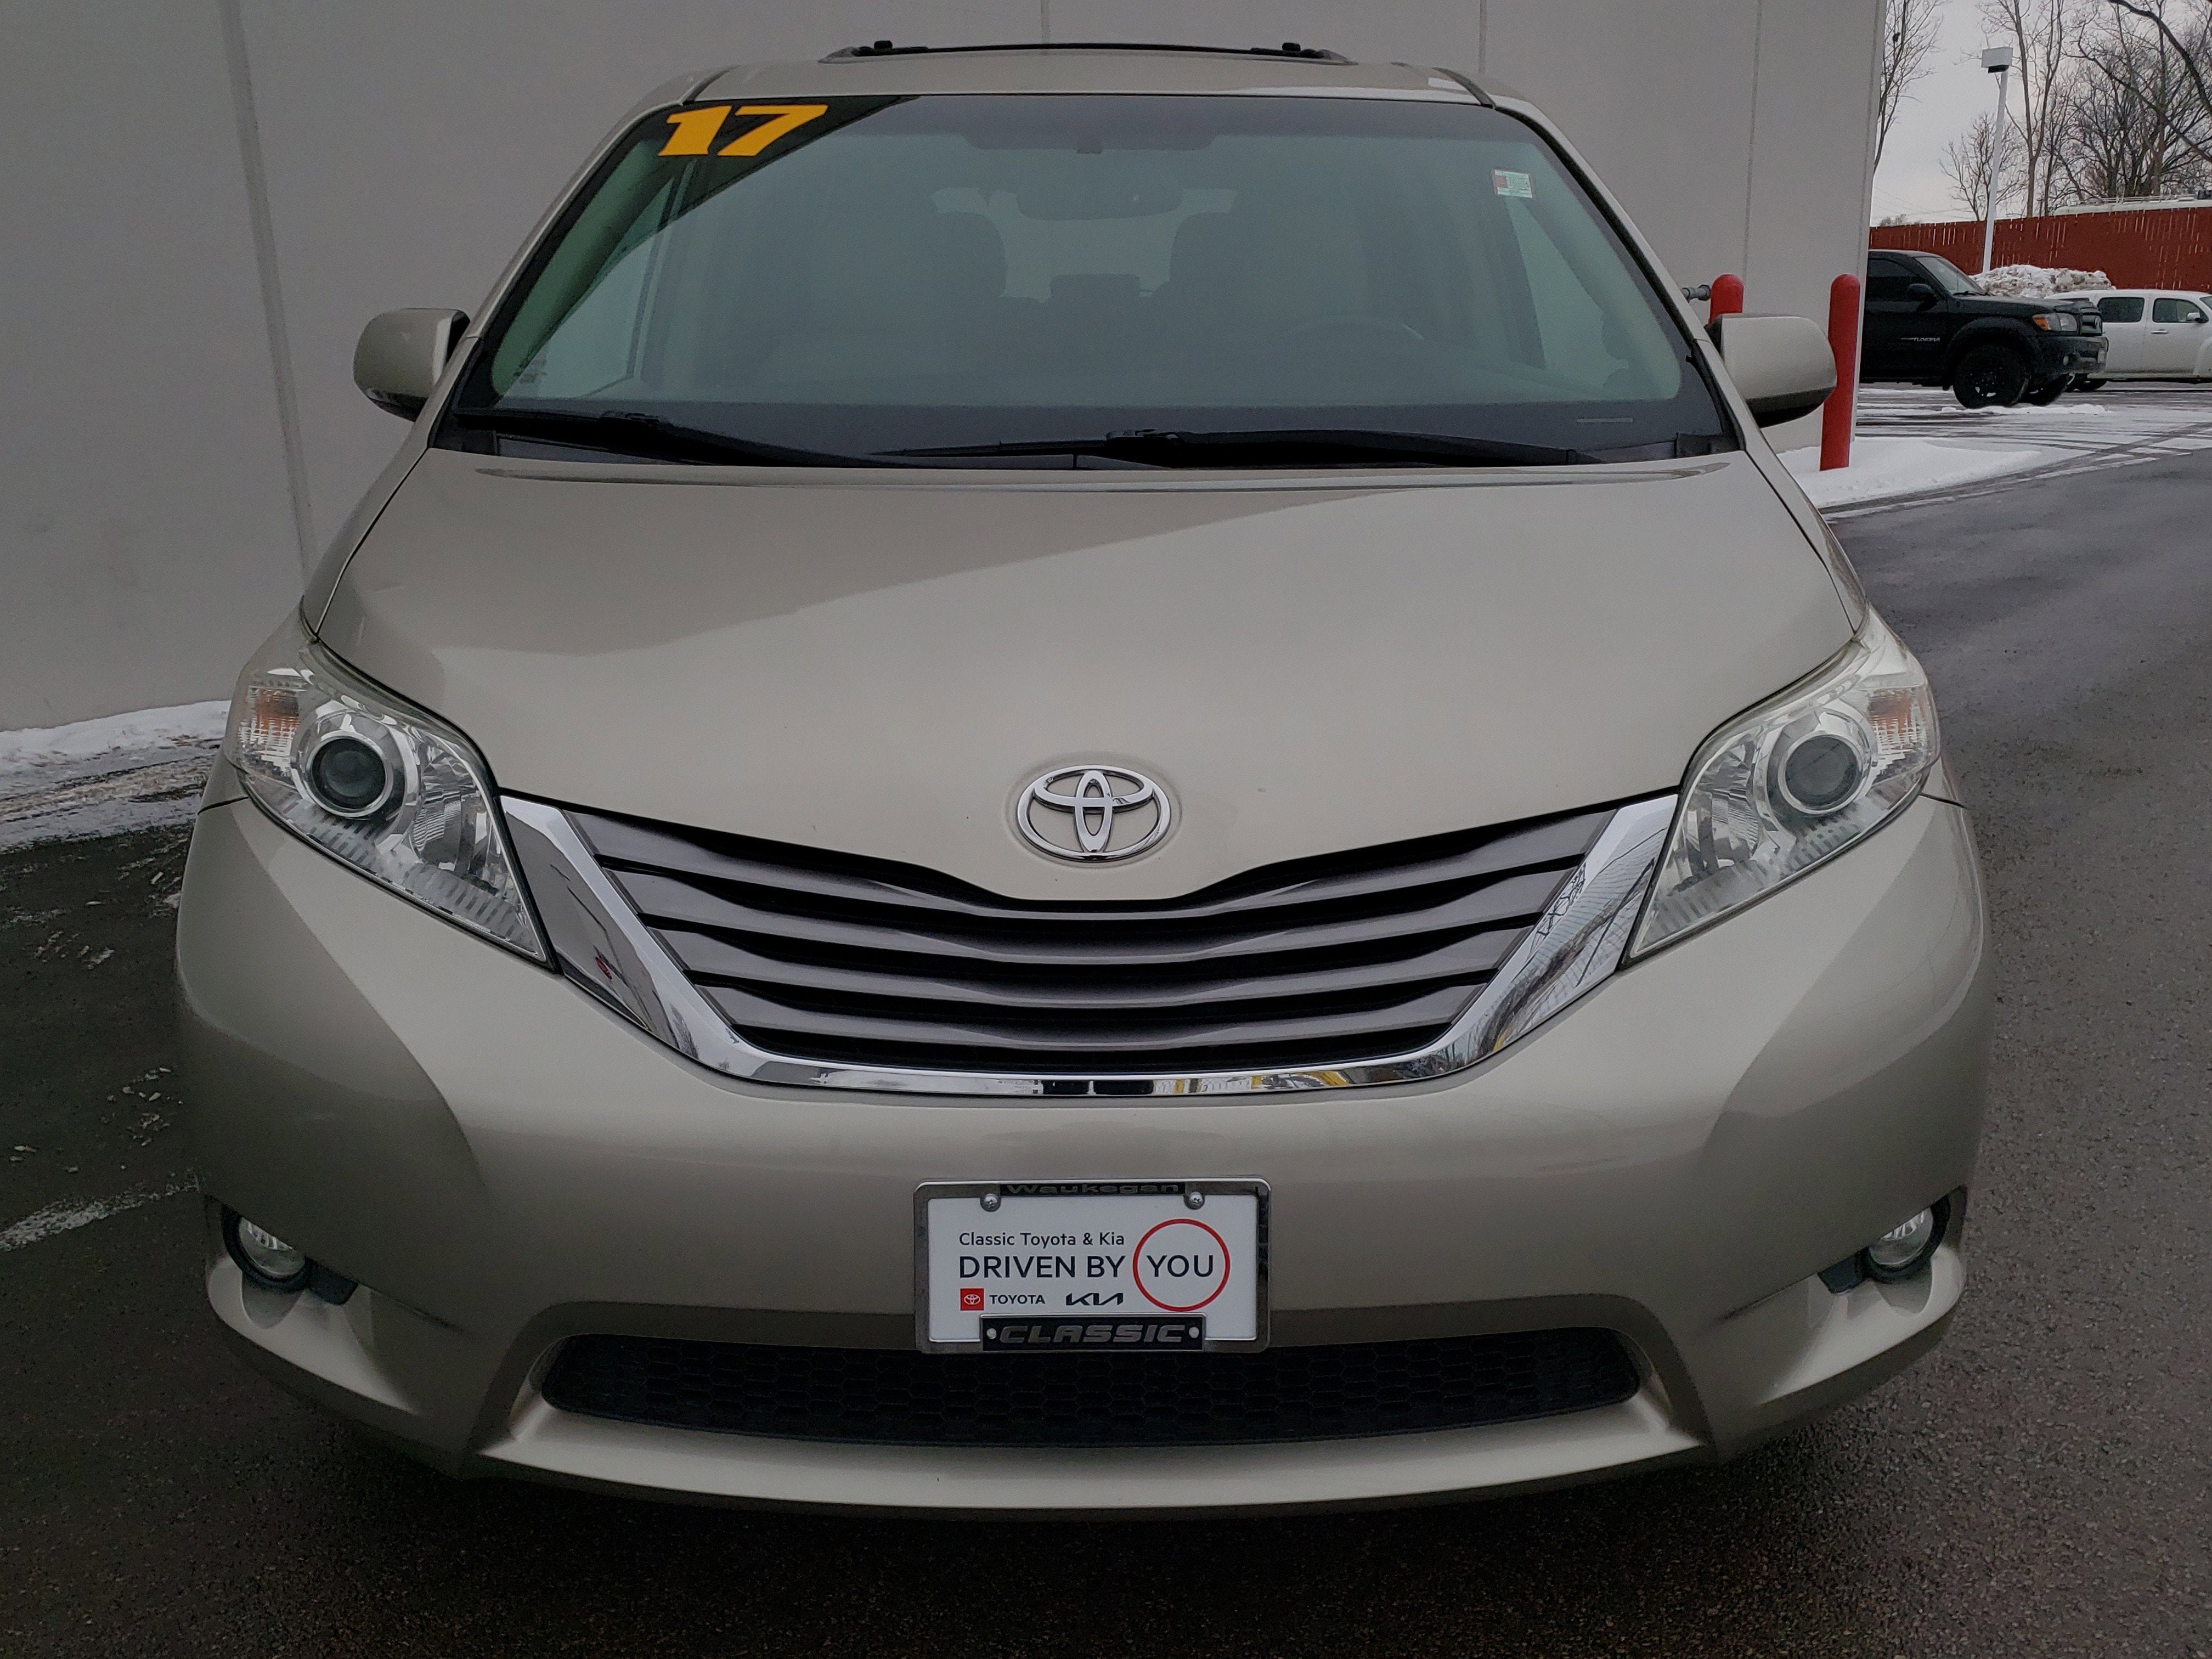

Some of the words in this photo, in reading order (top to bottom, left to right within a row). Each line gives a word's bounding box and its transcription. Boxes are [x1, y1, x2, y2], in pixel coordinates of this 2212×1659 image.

[658, 105, 828, 156] 17
[1006, 1184, 1179, 1194] Waukegan
[959, 1232, 1015, 1246] Classic
[1020, 1232, 1076, 1249] Toyota
[1083, 1232, 1093, 1246] &
[1099, 1232, 1124, 1245] Kia
[960, 1256, 1075, 1278] DRIVEN
[1087, 1256, 1126, 1278] BY
[1146, 1255, 1214, 1278] YOU
[989, 1294, 1046, 1305] TOYOTA
[1000, 1325, 1185, 1343] CLASSIC
